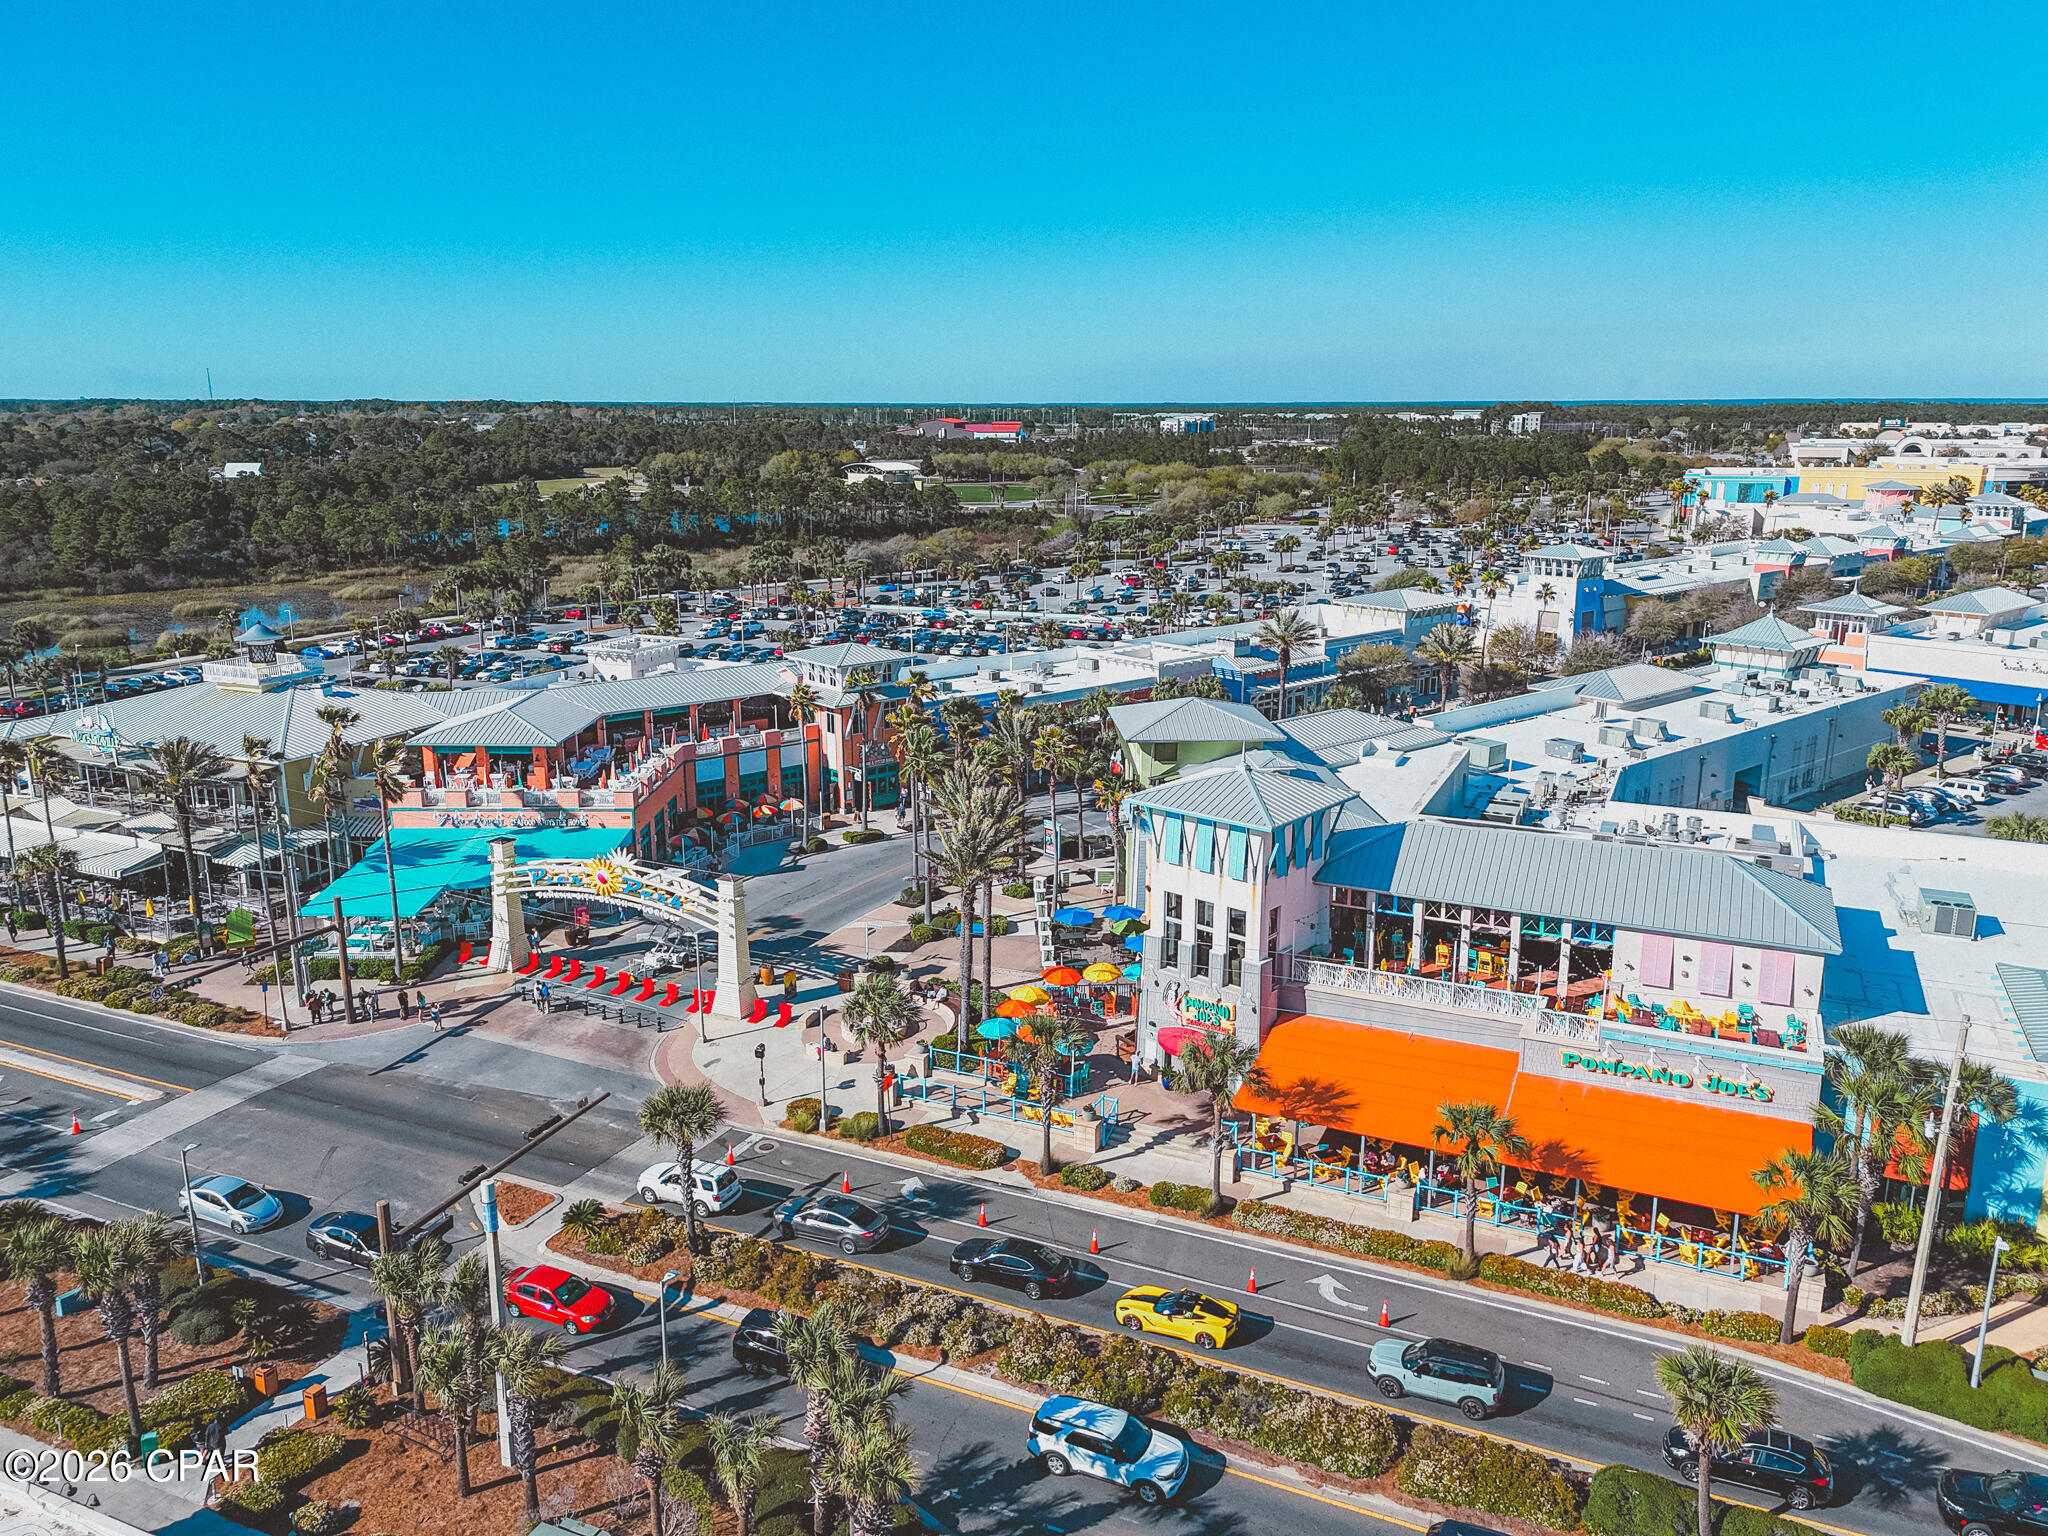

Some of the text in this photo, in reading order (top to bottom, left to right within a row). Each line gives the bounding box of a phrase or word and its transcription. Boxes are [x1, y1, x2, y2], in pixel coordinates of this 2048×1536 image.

[528, 868, 683, 909] Pier Park
[1184, 995, 1231, 1020] POMPANO
[1194, 1010, 1221, 1026] JOE'S
[1559, 1047, 1775, 1102] POMPANO JOE'S
